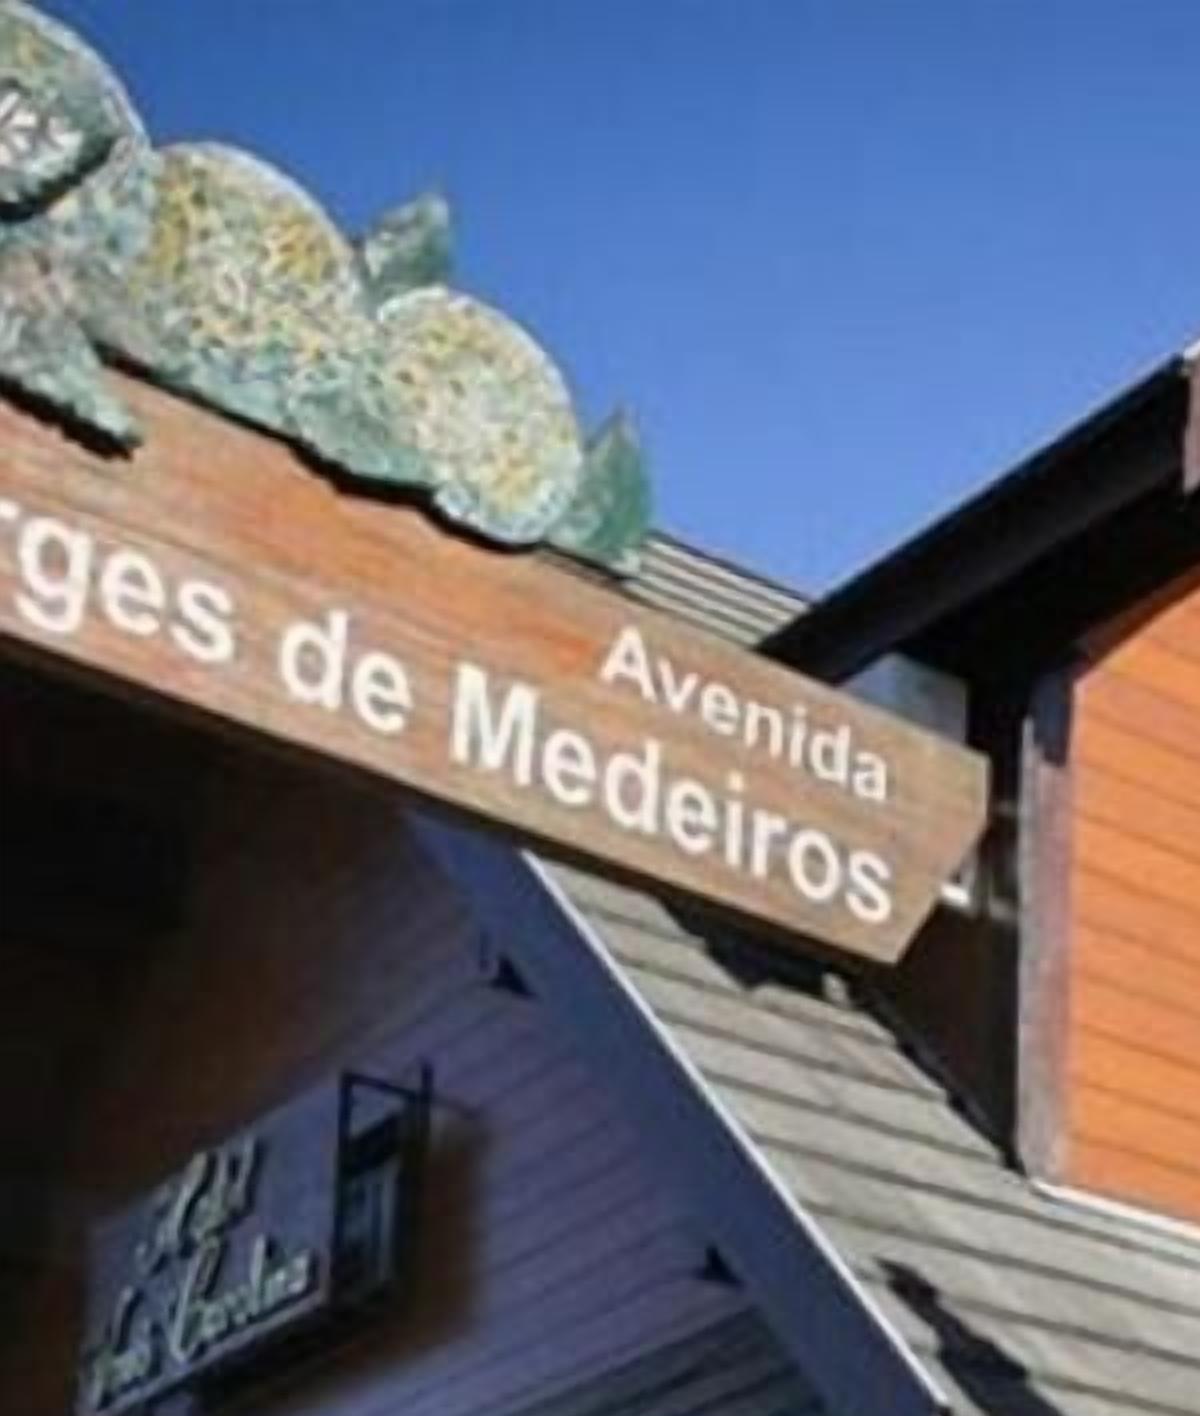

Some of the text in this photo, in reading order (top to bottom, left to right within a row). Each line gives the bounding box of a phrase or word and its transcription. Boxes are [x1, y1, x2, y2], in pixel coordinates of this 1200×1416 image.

[278, 608, 414, 735] de
[449, 661, 895, 926] Medeiros
[599, 625, 891, 804] Avenida
